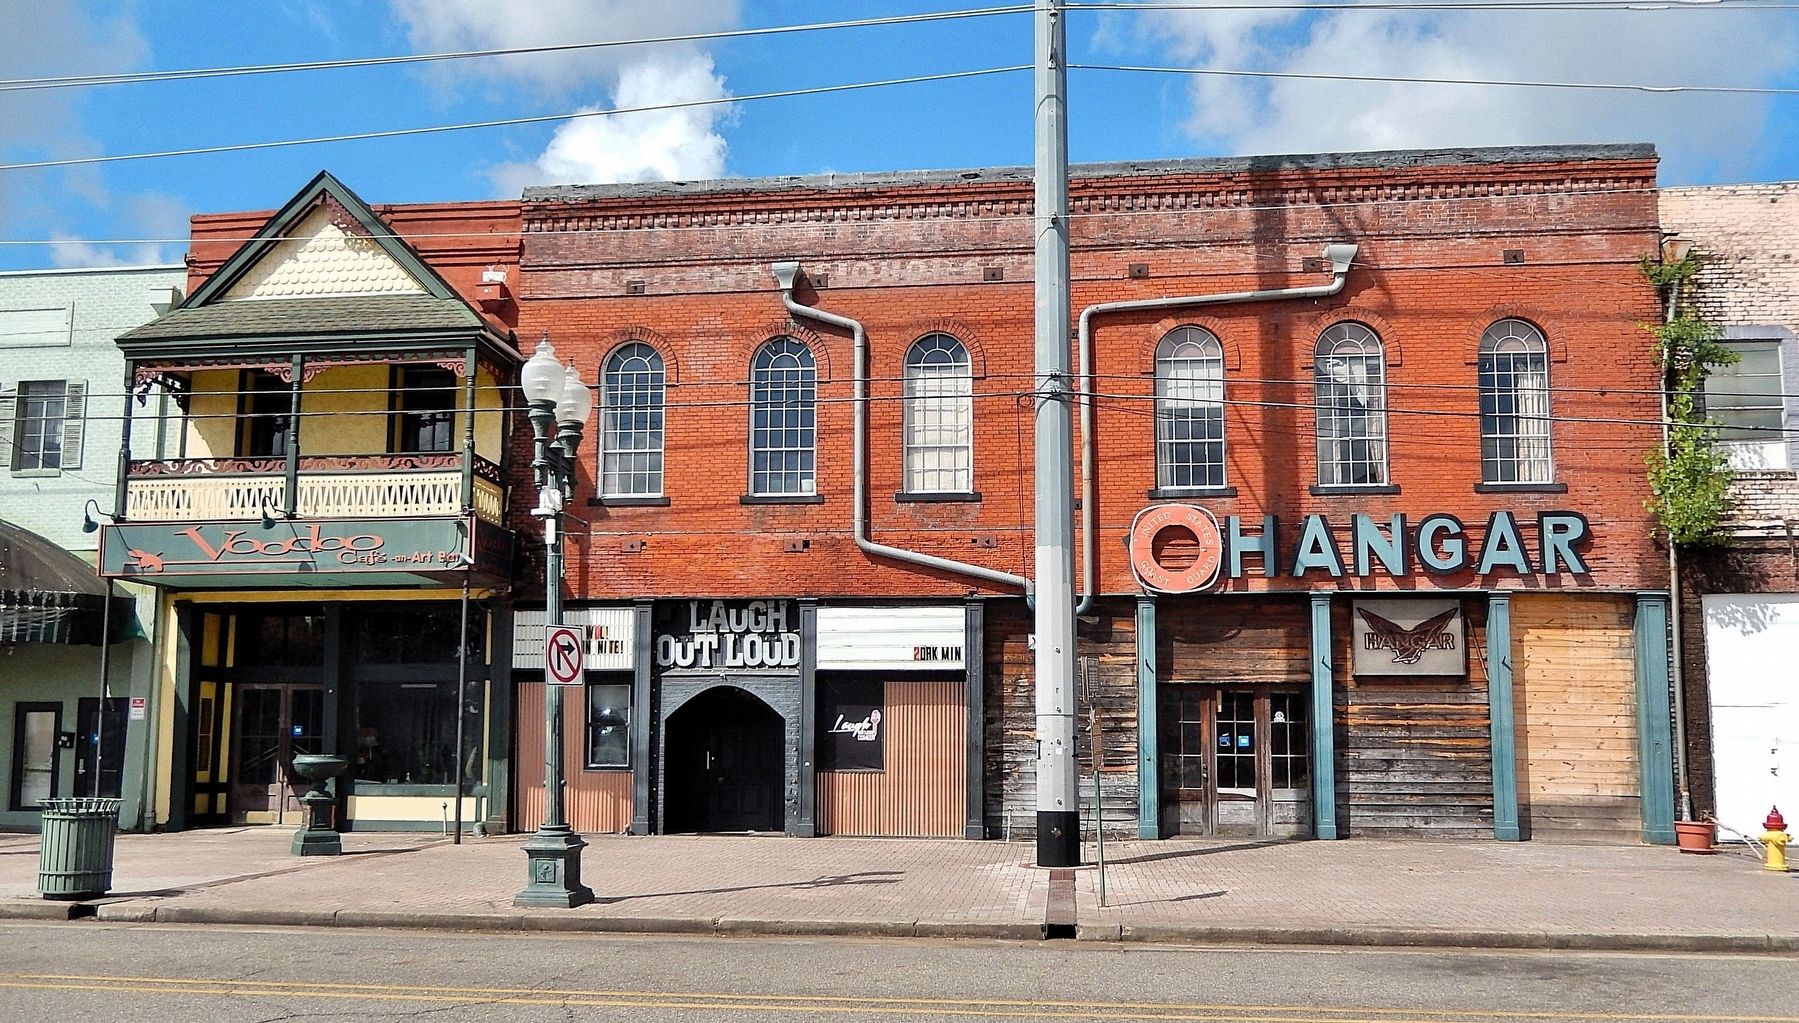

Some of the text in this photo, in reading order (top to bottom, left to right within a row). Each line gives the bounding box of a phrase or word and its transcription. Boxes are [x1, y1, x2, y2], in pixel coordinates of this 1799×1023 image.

[174, 524, 385, 561] Voodoo
[1141, 511, 1214, 545] UNITED STATES
[1225, 510, 1591, 578] HANGAR
[1141, 555, 1215, 586] COAST GUARD
[689, 600, 788, 633] LAUGH
[656, 632, 801, 667] OUT LOUD
[941, 646, 961, 661] MIN
[1364, 632, 1455, 650] HANGAR
